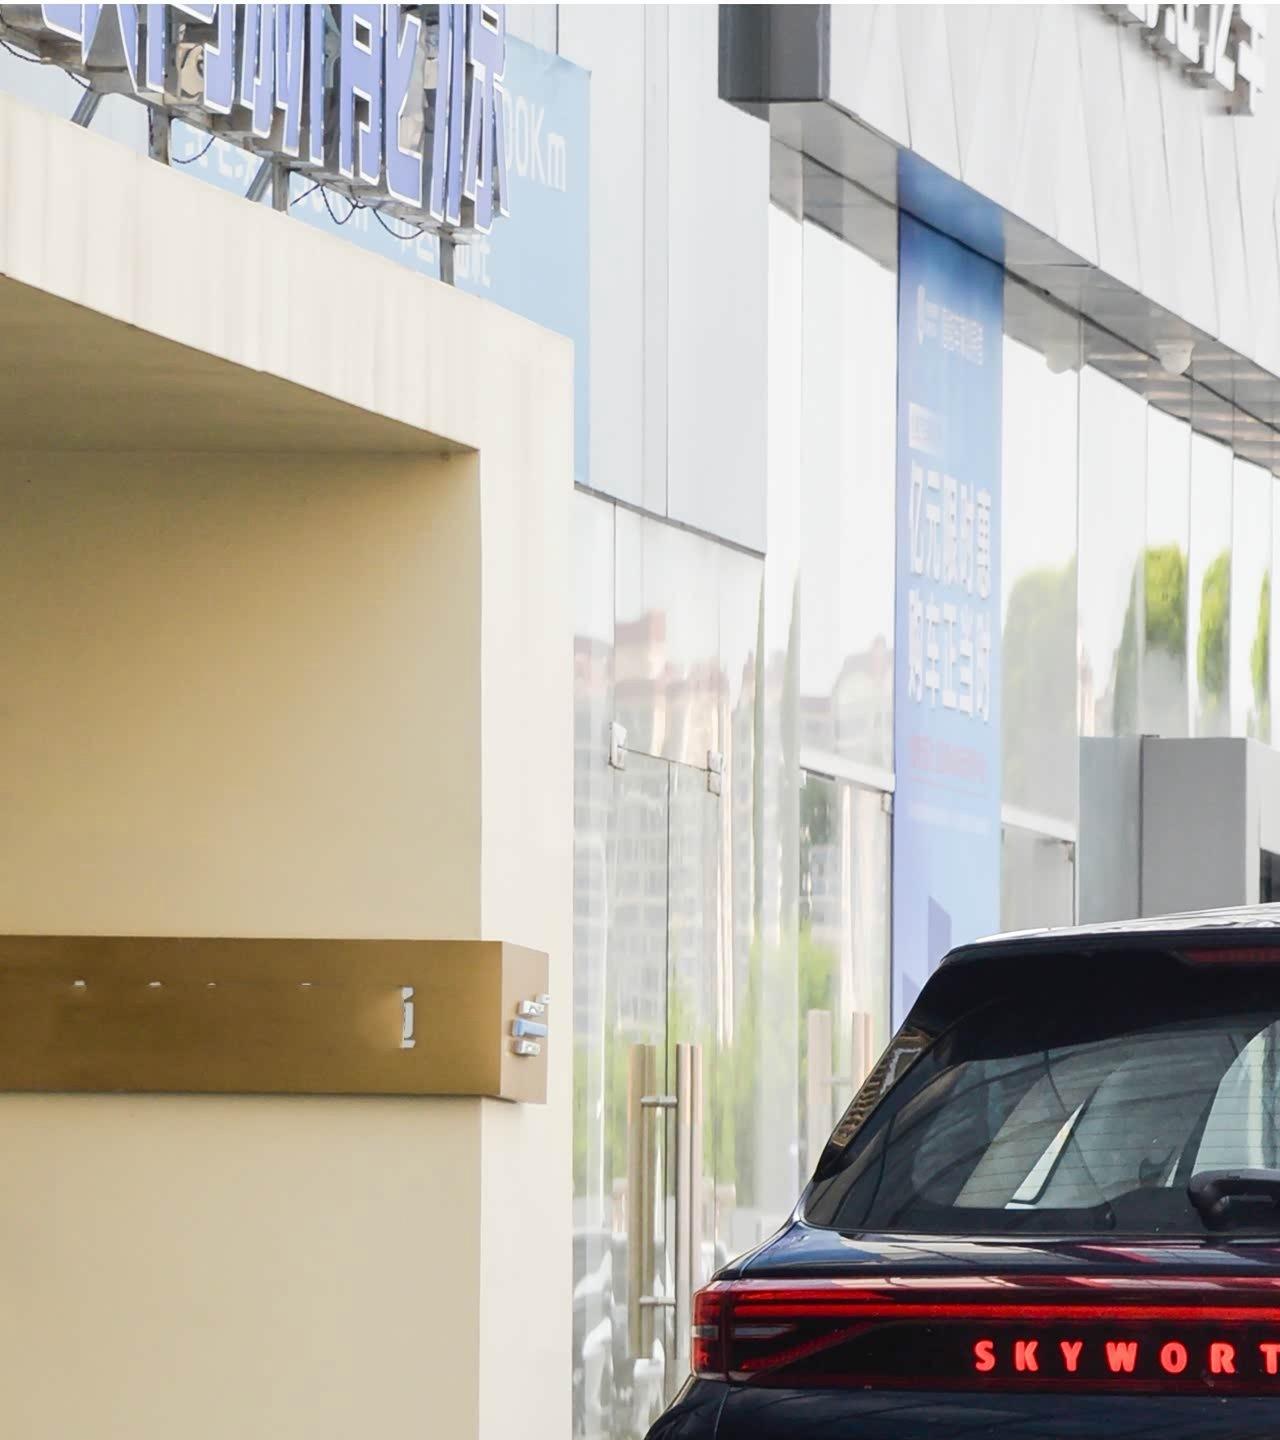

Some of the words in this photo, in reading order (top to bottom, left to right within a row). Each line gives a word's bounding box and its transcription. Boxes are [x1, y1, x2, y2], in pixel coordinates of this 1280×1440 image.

[909, 460, 991, 599] 亿元限时惠
[908, 588, 991, 725] 购车正当时
